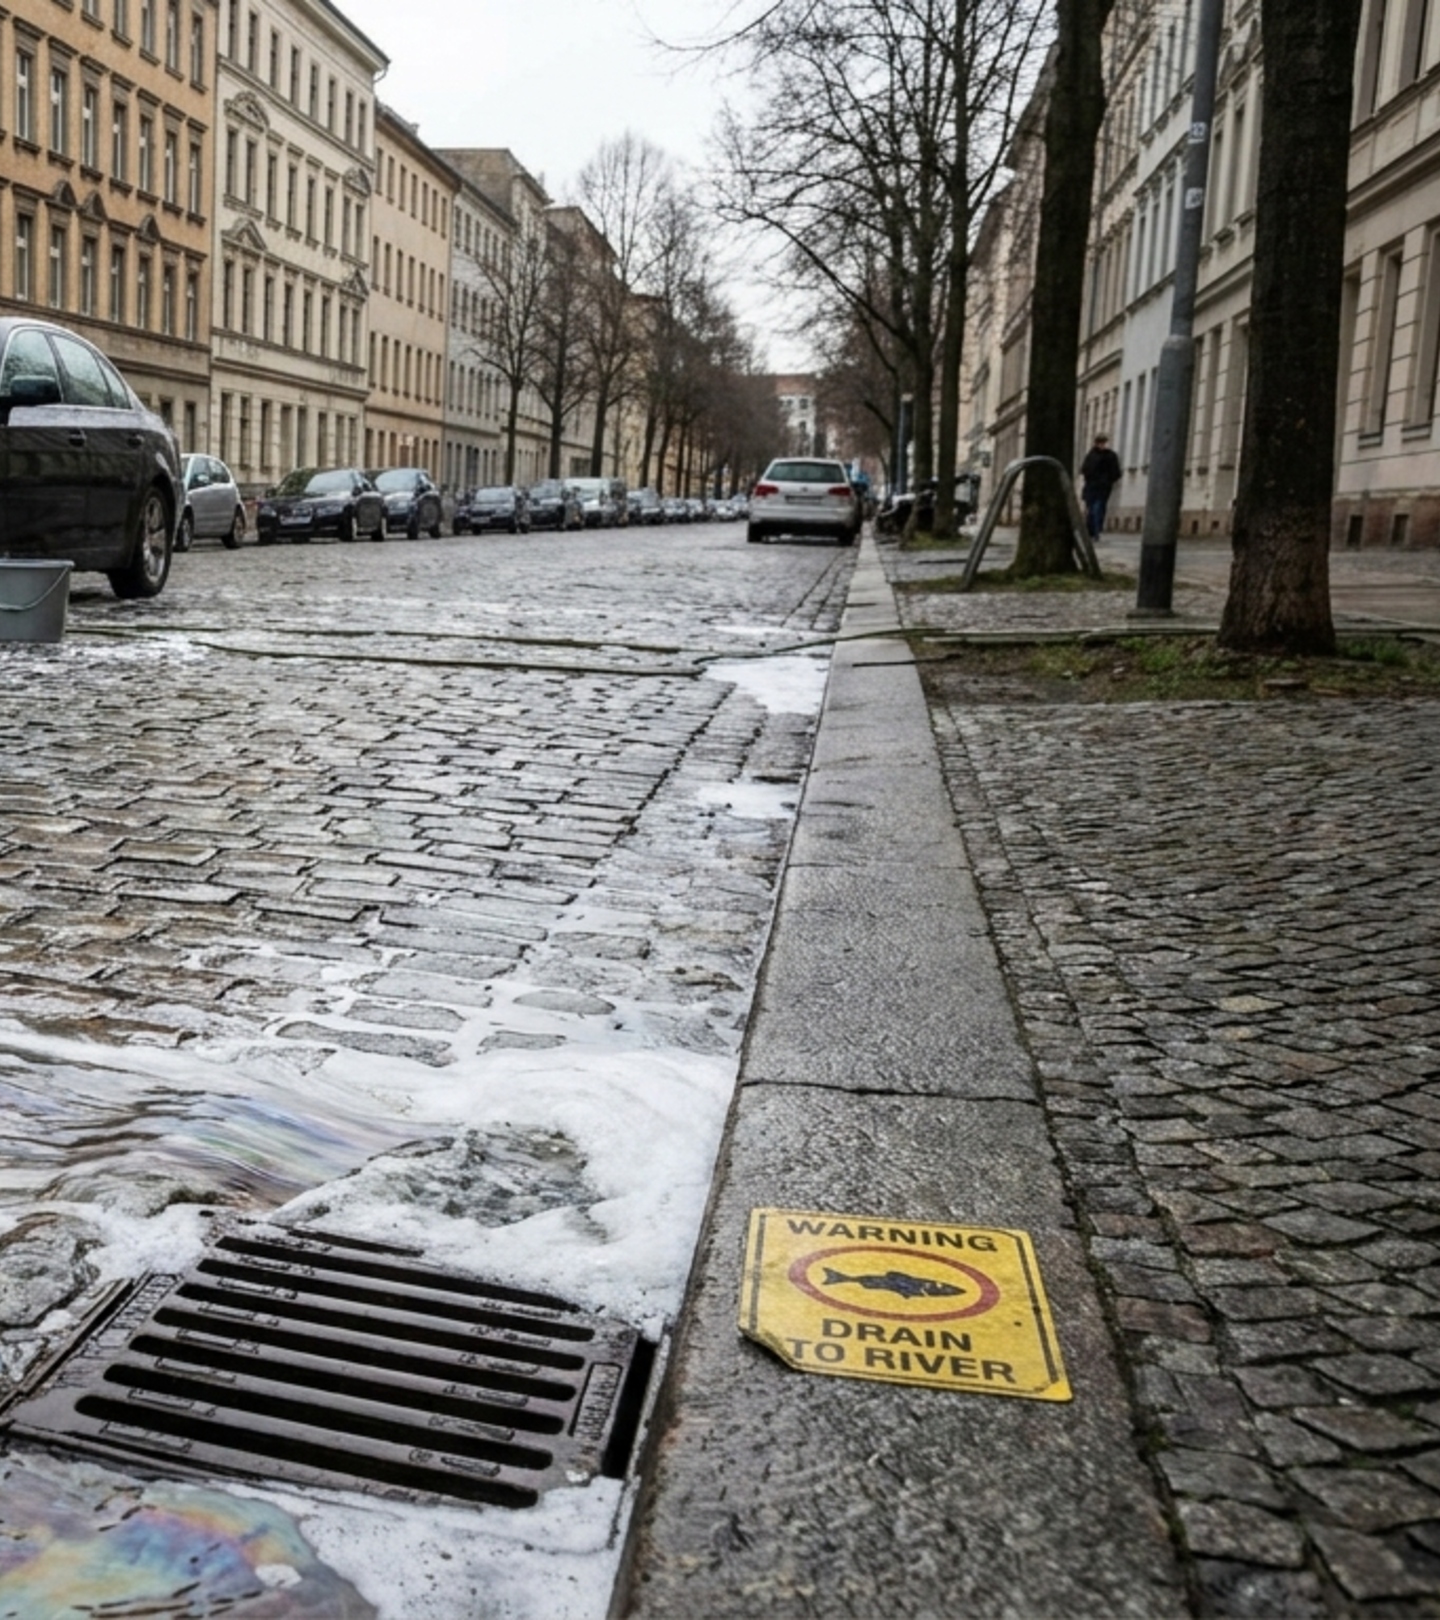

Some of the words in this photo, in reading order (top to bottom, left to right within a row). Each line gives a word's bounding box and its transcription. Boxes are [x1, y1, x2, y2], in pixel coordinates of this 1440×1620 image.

[787, 1219, 998, 1251] WARNING
[822, 1318, 971, 1352] DRAIN
[786, 1338, 845, 1363] TO
[864, 1347, 1015, 1383] RIVER
